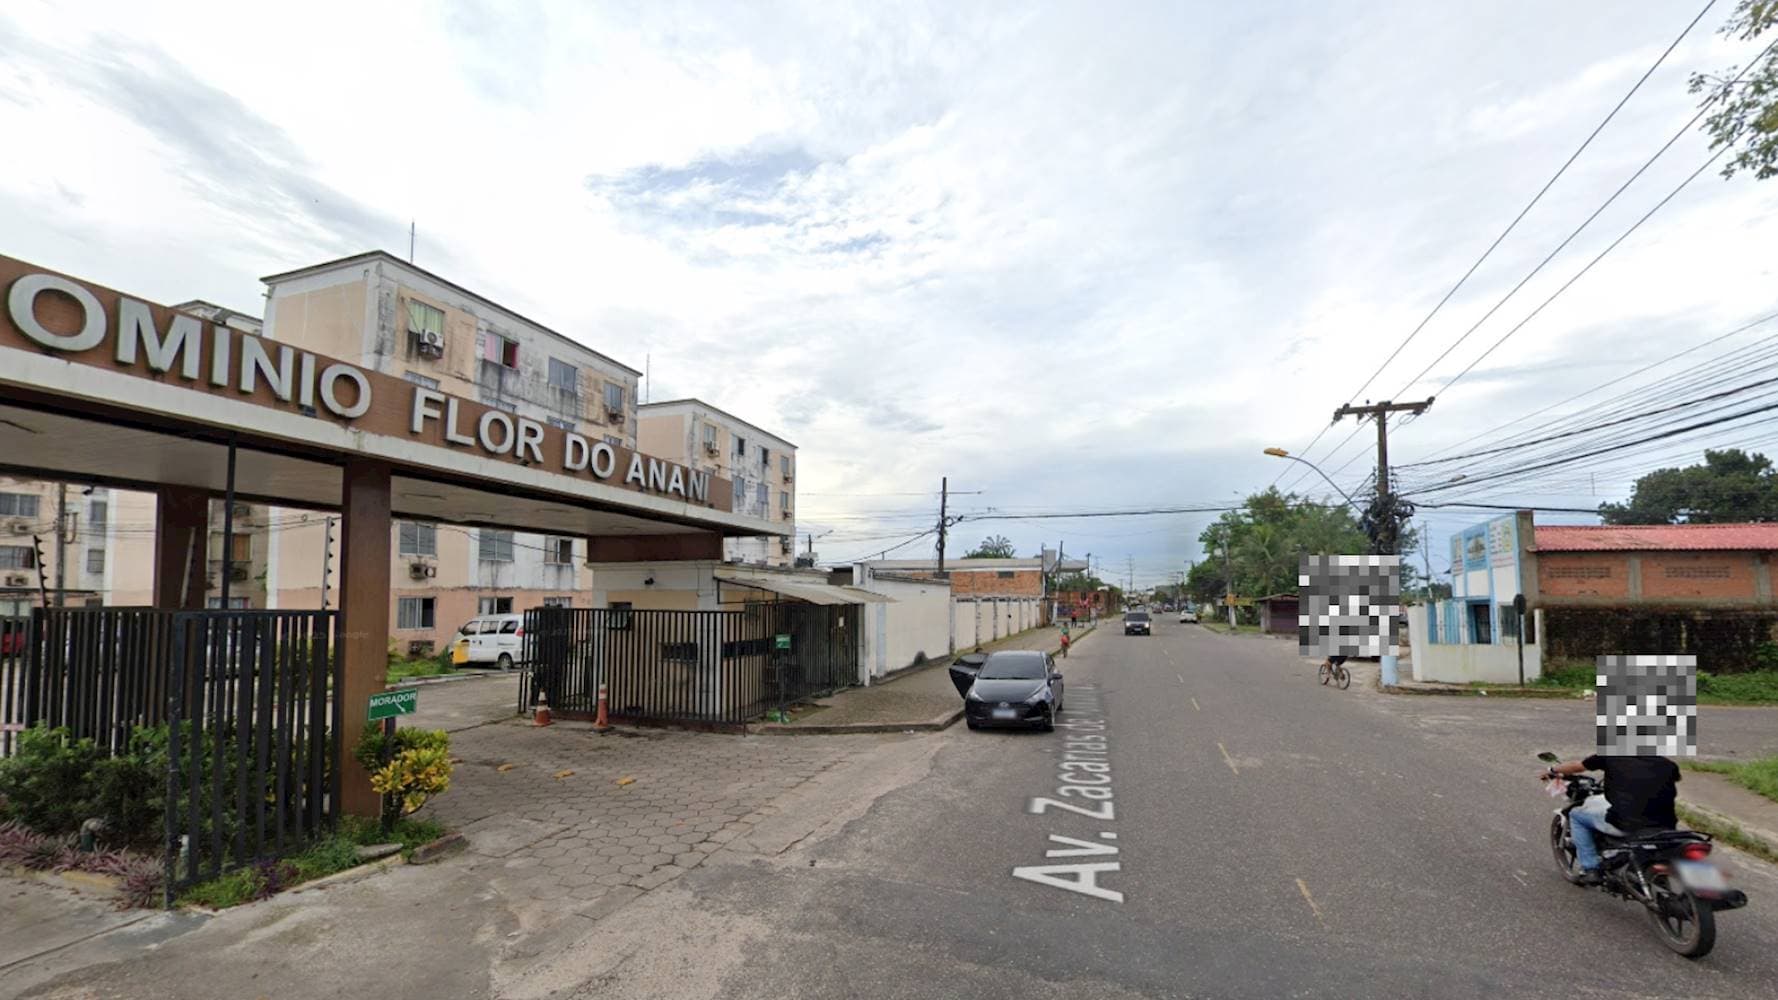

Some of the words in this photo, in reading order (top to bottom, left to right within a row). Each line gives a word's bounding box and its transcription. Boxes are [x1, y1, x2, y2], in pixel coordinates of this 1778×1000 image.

[8, 273, 372, 419] OMINIO
[411, 387, 545, 464] FLOR
[564, 431, 616, 480] DO
[369, 692, 417, 708] MORADOR
